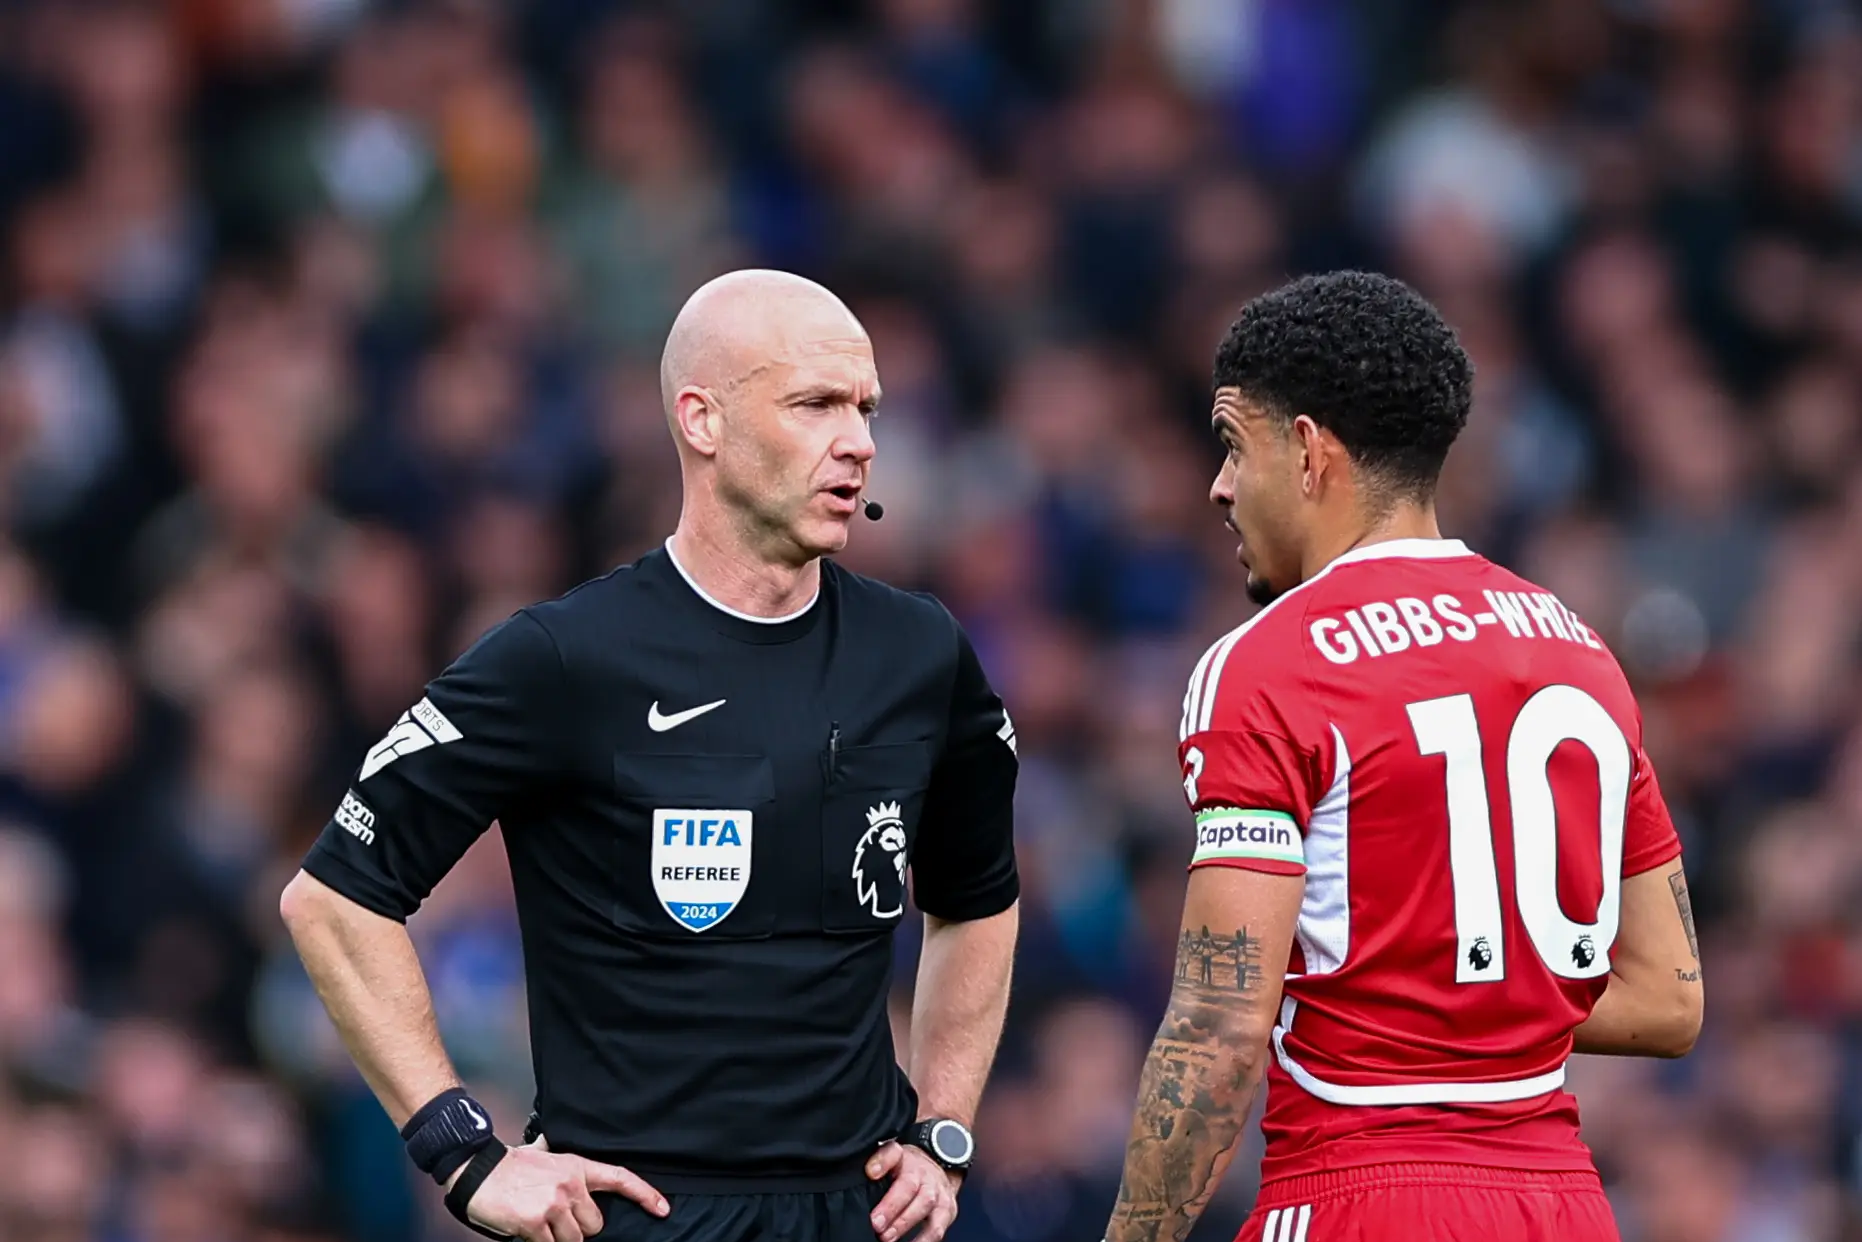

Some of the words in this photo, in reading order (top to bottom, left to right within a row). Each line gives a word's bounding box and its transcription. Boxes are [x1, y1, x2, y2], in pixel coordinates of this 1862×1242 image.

[1309, 589, 1602, 665] GIBBS-WHITE
[663, 819, 742, 846] FIFA
[1200, 821, 1290, 849] Captain
[1405, 683, 1632, 984] 10
[661, 866, 741, 881] REFEREE
[681, 905, 718, 919] 2024
